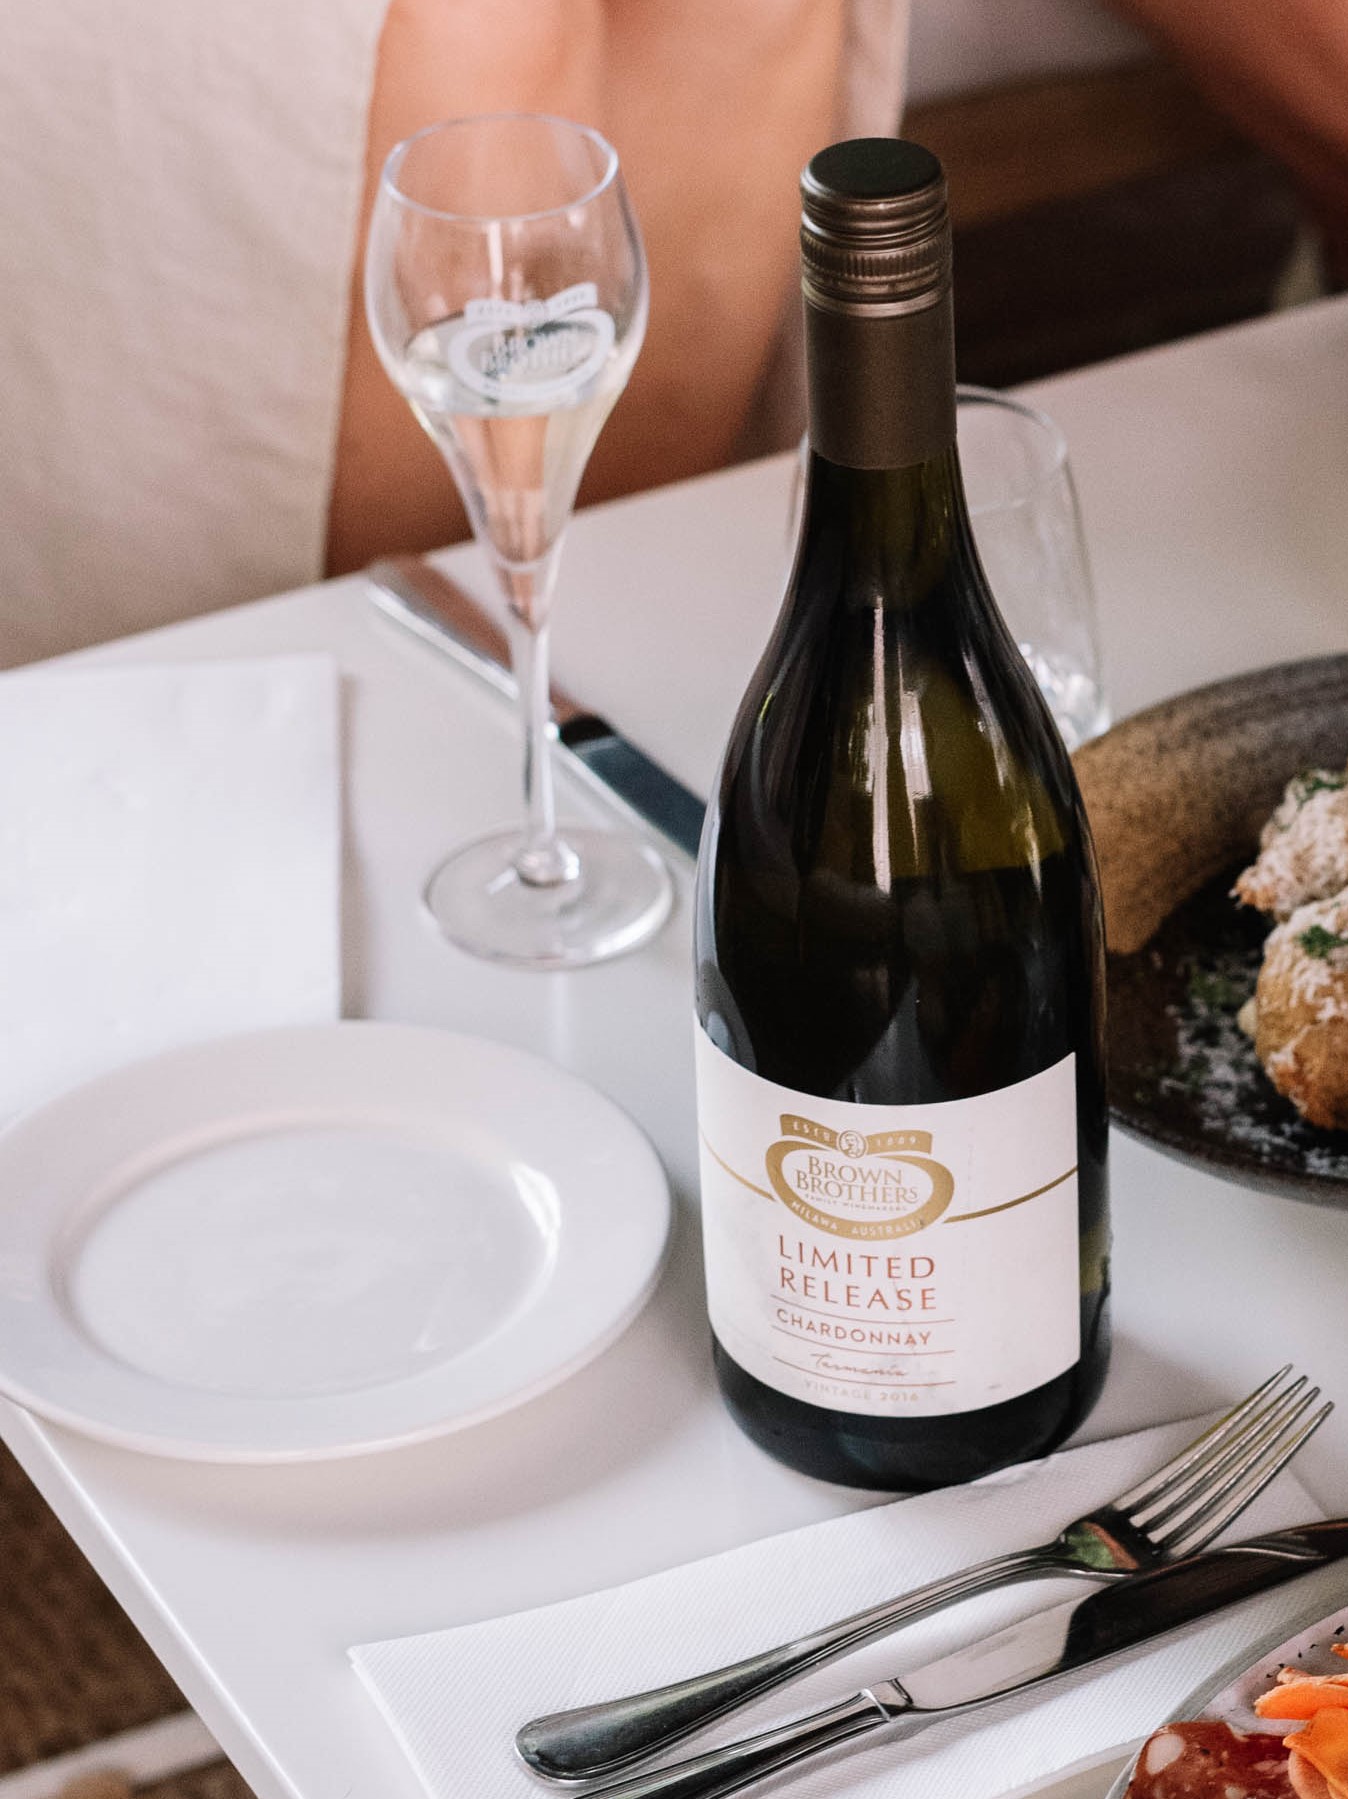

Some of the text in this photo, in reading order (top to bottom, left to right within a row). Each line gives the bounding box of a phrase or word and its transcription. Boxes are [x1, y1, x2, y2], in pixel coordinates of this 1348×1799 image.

[795, 1169, 919, 1204] BROTHERS
[807, 1155, 903, 1186] BROWN
[791, 1200, 838, 1231] MILAWA
[779, 1234, 936, 1279] LIMITED
[780, 1266, 937, 1311] RELEASE
[776, 1308, 932, 1346] CHARDONNAY
[810, 1352, 908, 1377] Tasmania
[803, 1380, 920, 1402] VINTAGE 2016
